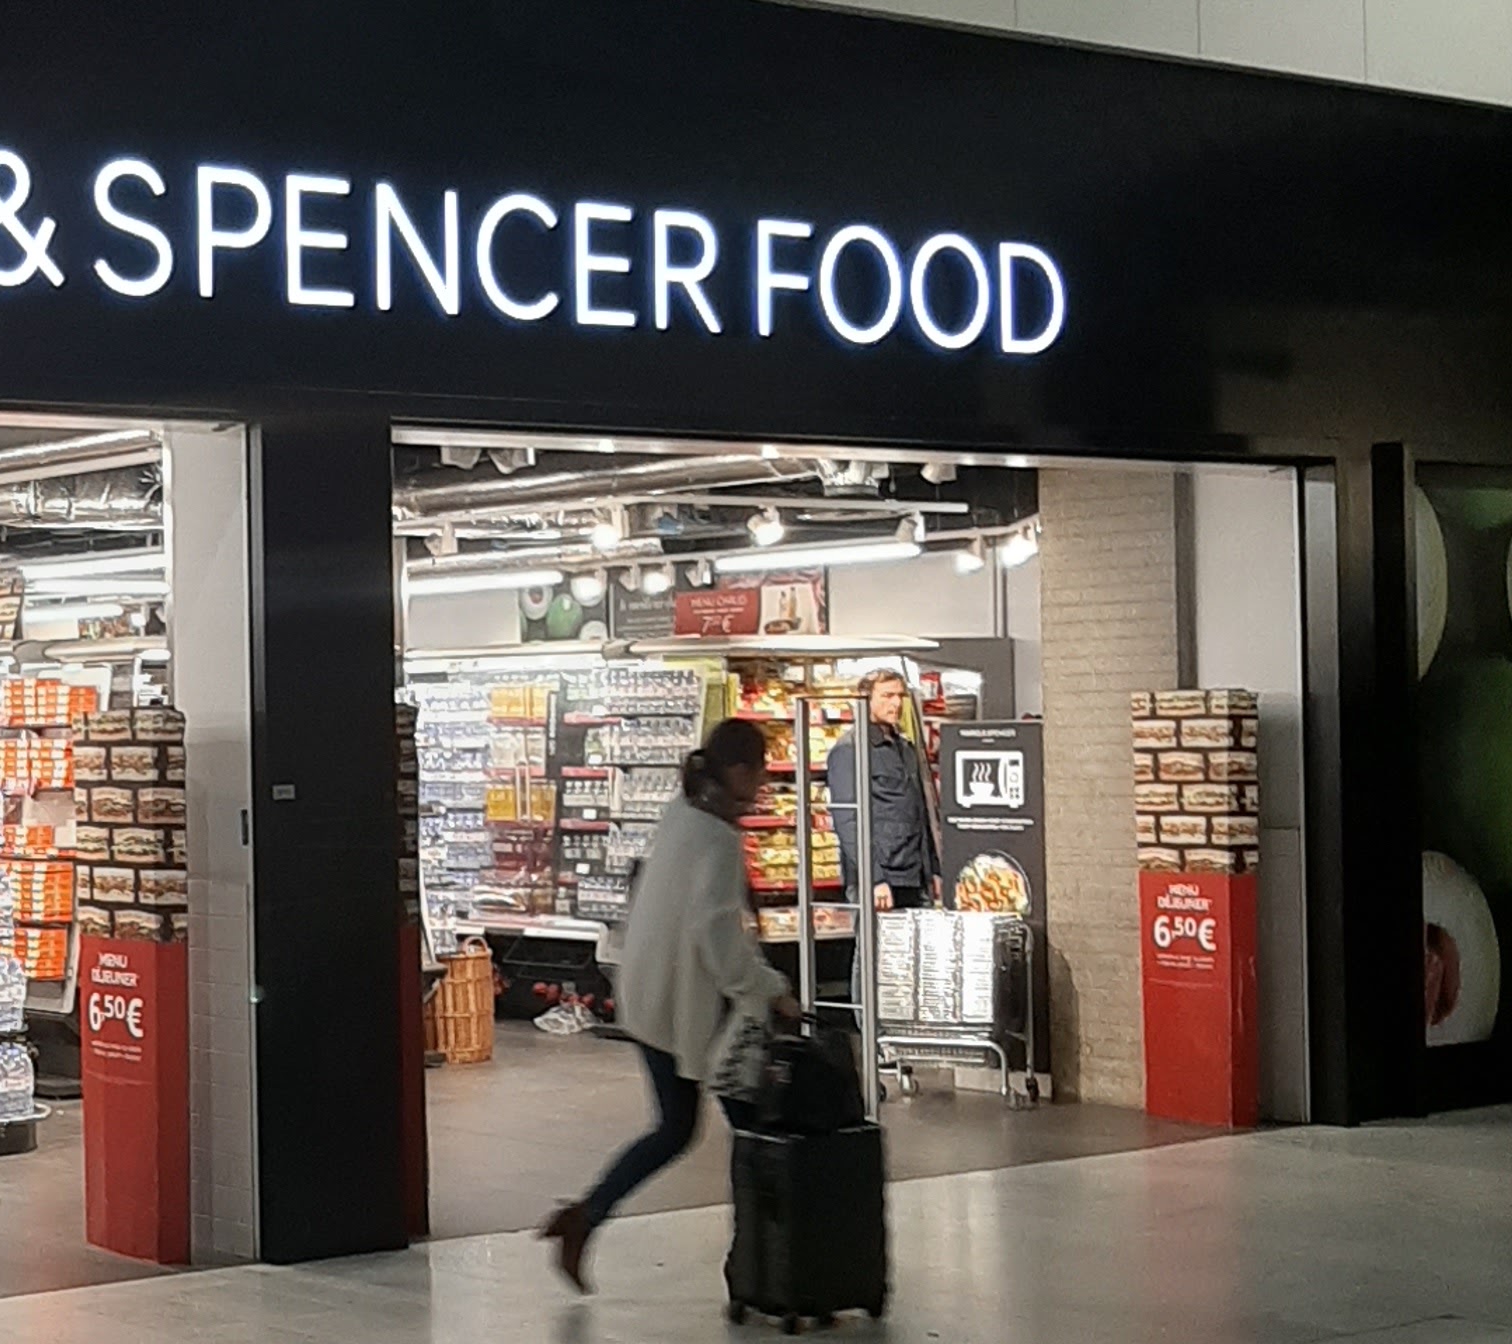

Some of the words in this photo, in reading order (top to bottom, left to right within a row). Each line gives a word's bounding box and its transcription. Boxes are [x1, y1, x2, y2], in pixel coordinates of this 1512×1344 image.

[92, 157, 722, 335] SPENCER
[755, 219, 1066, 355] FOOD
[1153, 915, 1217, 952] 6,50€
[89, 992, 144, 1038] 6,50€
